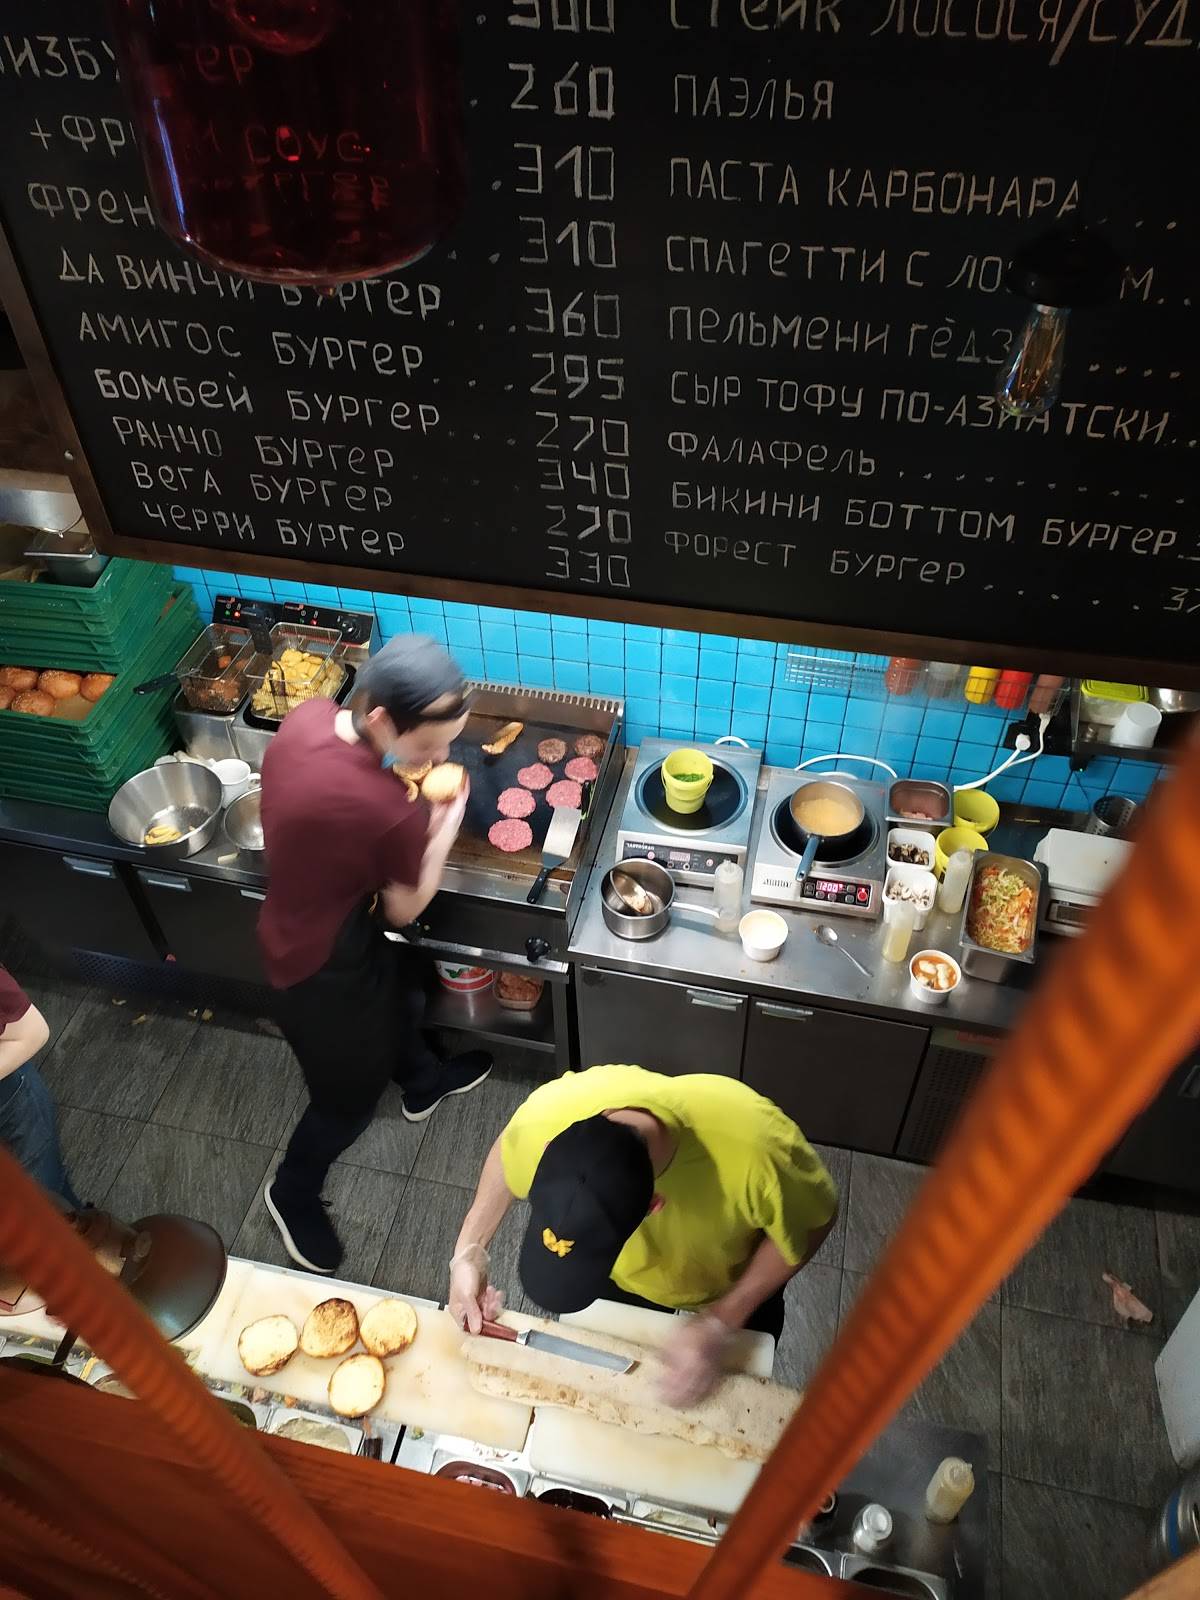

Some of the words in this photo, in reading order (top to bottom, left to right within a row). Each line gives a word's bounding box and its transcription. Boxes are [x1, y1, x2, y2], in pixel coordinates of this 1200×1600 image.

[508, 61, 615, 120] 260
[674, 73, 834, 120] ПАЭЛЬЯ
[513, 143, 615, 200] 310
[669, 157, 799, 205] ПАСТА
[827, 168, 1080, 219] КАРБОНАРА
[519, 215, 617, 268] 310
[906, 250, 930, 287] С
[59, 247, 104, 285] ДА
[116, 253, 255, 301] ВИНЧИ
[524, 285, 620, 339] 360
[79, 312, 241, 358] АМИГОС
[530, 352, 625, 400] 295
[671, 370, 742, 408] СЫР
[756, 377, 864, 418] ТОФУ
[112, 416, 222, 458] РАНЧО
[538, 458, 630, 500] 340
[535, 411, 630, 457] 270
[546, 504, 632, 544] 270
[672, 481, 820, 522] БИКИНИ
[845, 499, 1016, 543] БОТТОМ
[546, 545, 631, 588] 330
